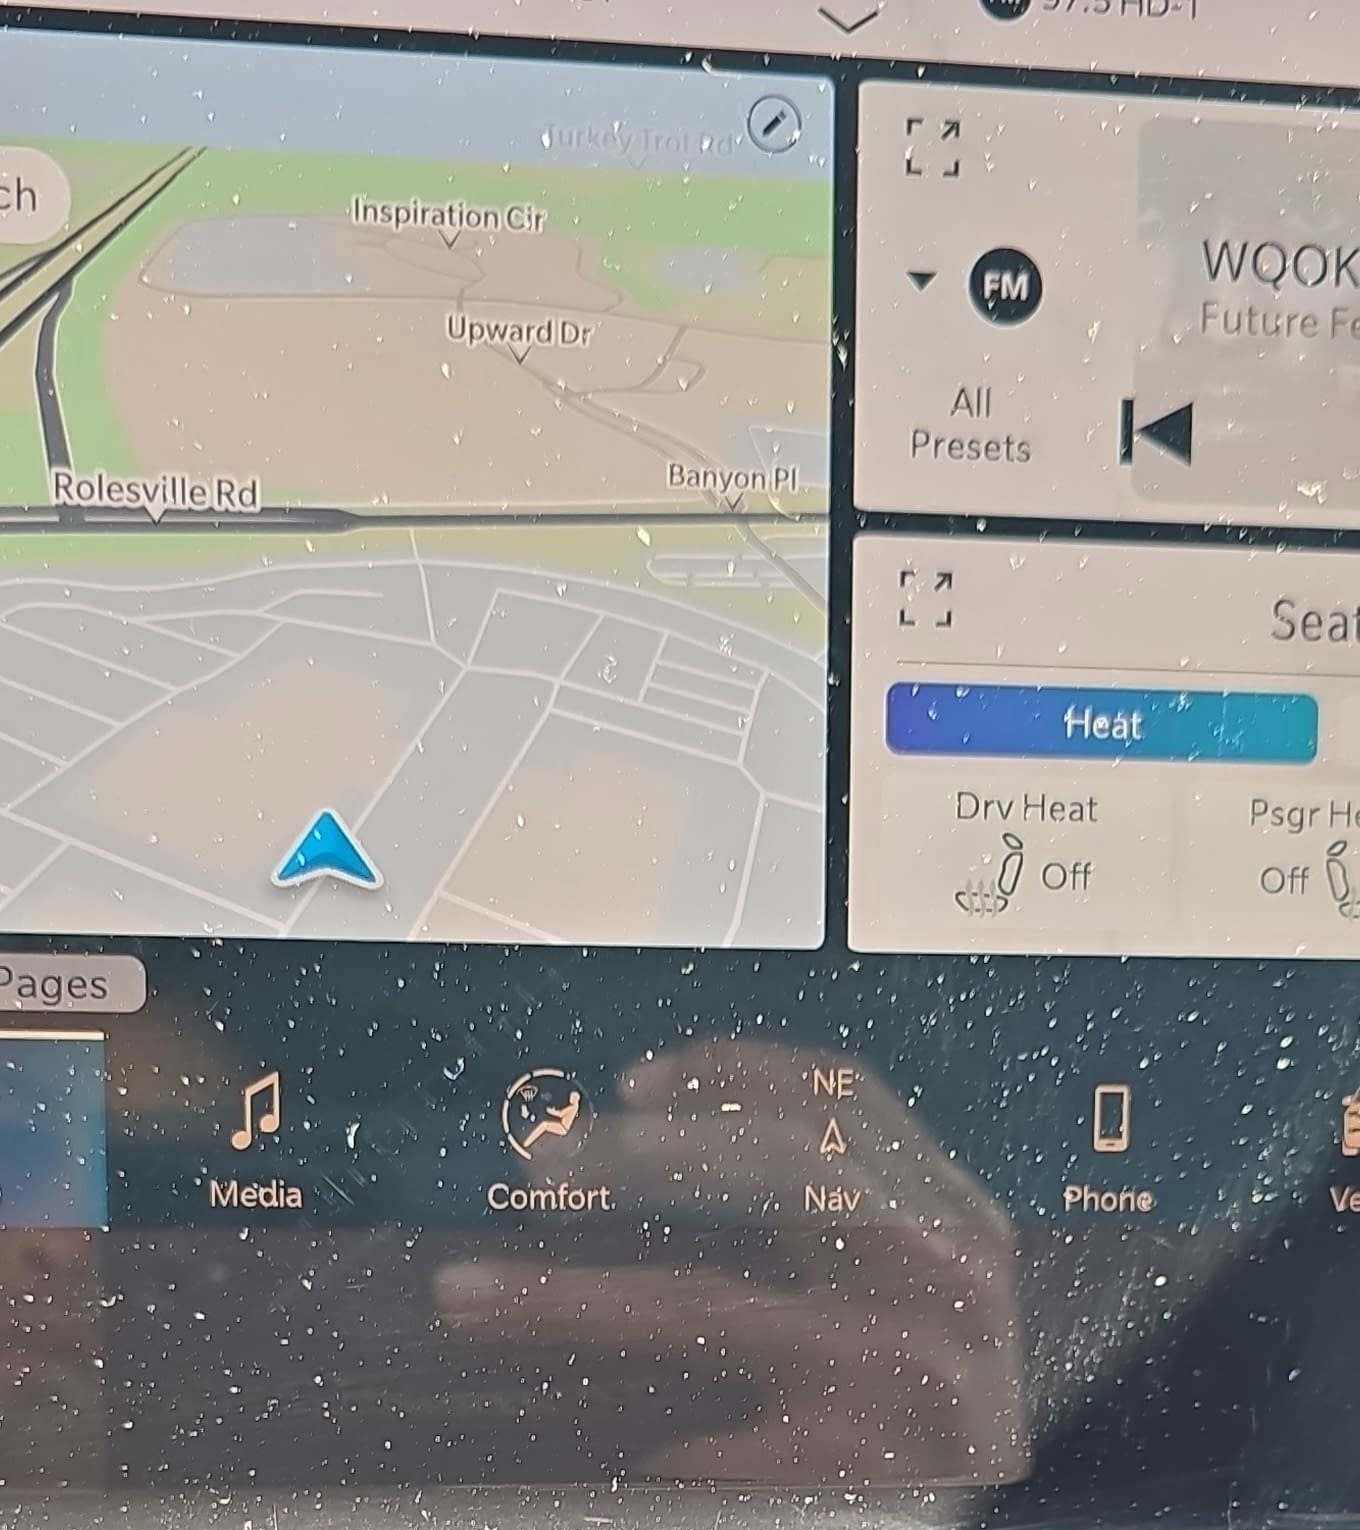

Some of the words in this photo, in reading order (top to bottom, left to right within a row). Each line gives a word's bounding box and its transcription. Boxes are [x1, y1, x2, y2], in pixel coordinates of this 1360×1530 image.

[353, 199, 499, 231] Inspiration
[507, 206, 546, 233] Cir
[983, 273, 1028, 302] FM
[447, 315, 553, 347] Upward
[560, 320, 592, 347] Dr
[1201, 302, 1319, 339] Future
[950, 386, 992, 418] All
[912, 428, 1031, 463] Presets
[55, 472, 208, 508] Rolesville
[217, 480, 258, 510] Rd
[669, 463, 767, 492] Banyon
[774, 467, 797, 492] Pl
[1064, 705, 1144, 741] Heat
[957, 792, 1013, 821] Drv
[1023, 793, 1098, 823] Heat
[1250, 799, 1320, 833] Psgr
[1041, 861, 1093, 891] Off
[1260, 865, 1310, 896] Off
[812, 1068, 855, 1099] NE
[210, 1179, 304, 1210] Media
[487, 1182, 612, 1211] Comfort
[804, 1185, 862, 1212] Nav
[1064, 1185, 1155, 1214] Phone
